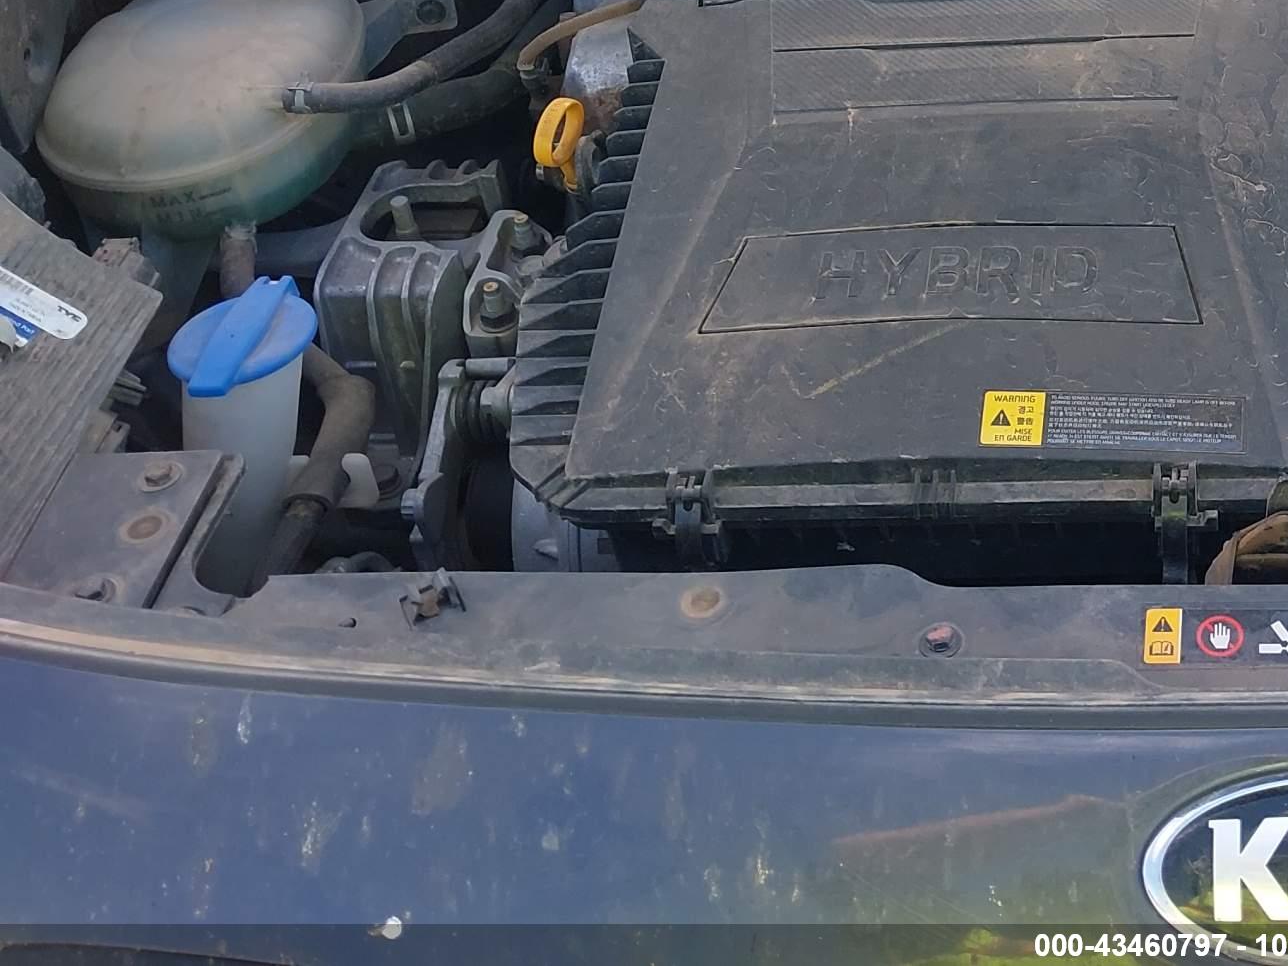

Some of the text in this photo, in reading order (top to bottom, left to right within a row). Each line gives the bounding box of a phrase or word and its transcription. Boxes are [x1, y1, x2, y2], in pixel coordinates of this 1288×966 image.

[149, 191, 196, 208] MAX
[814, 245, 1099, 299] HYBRID
[994, 395, 1036, 403] WARNING
